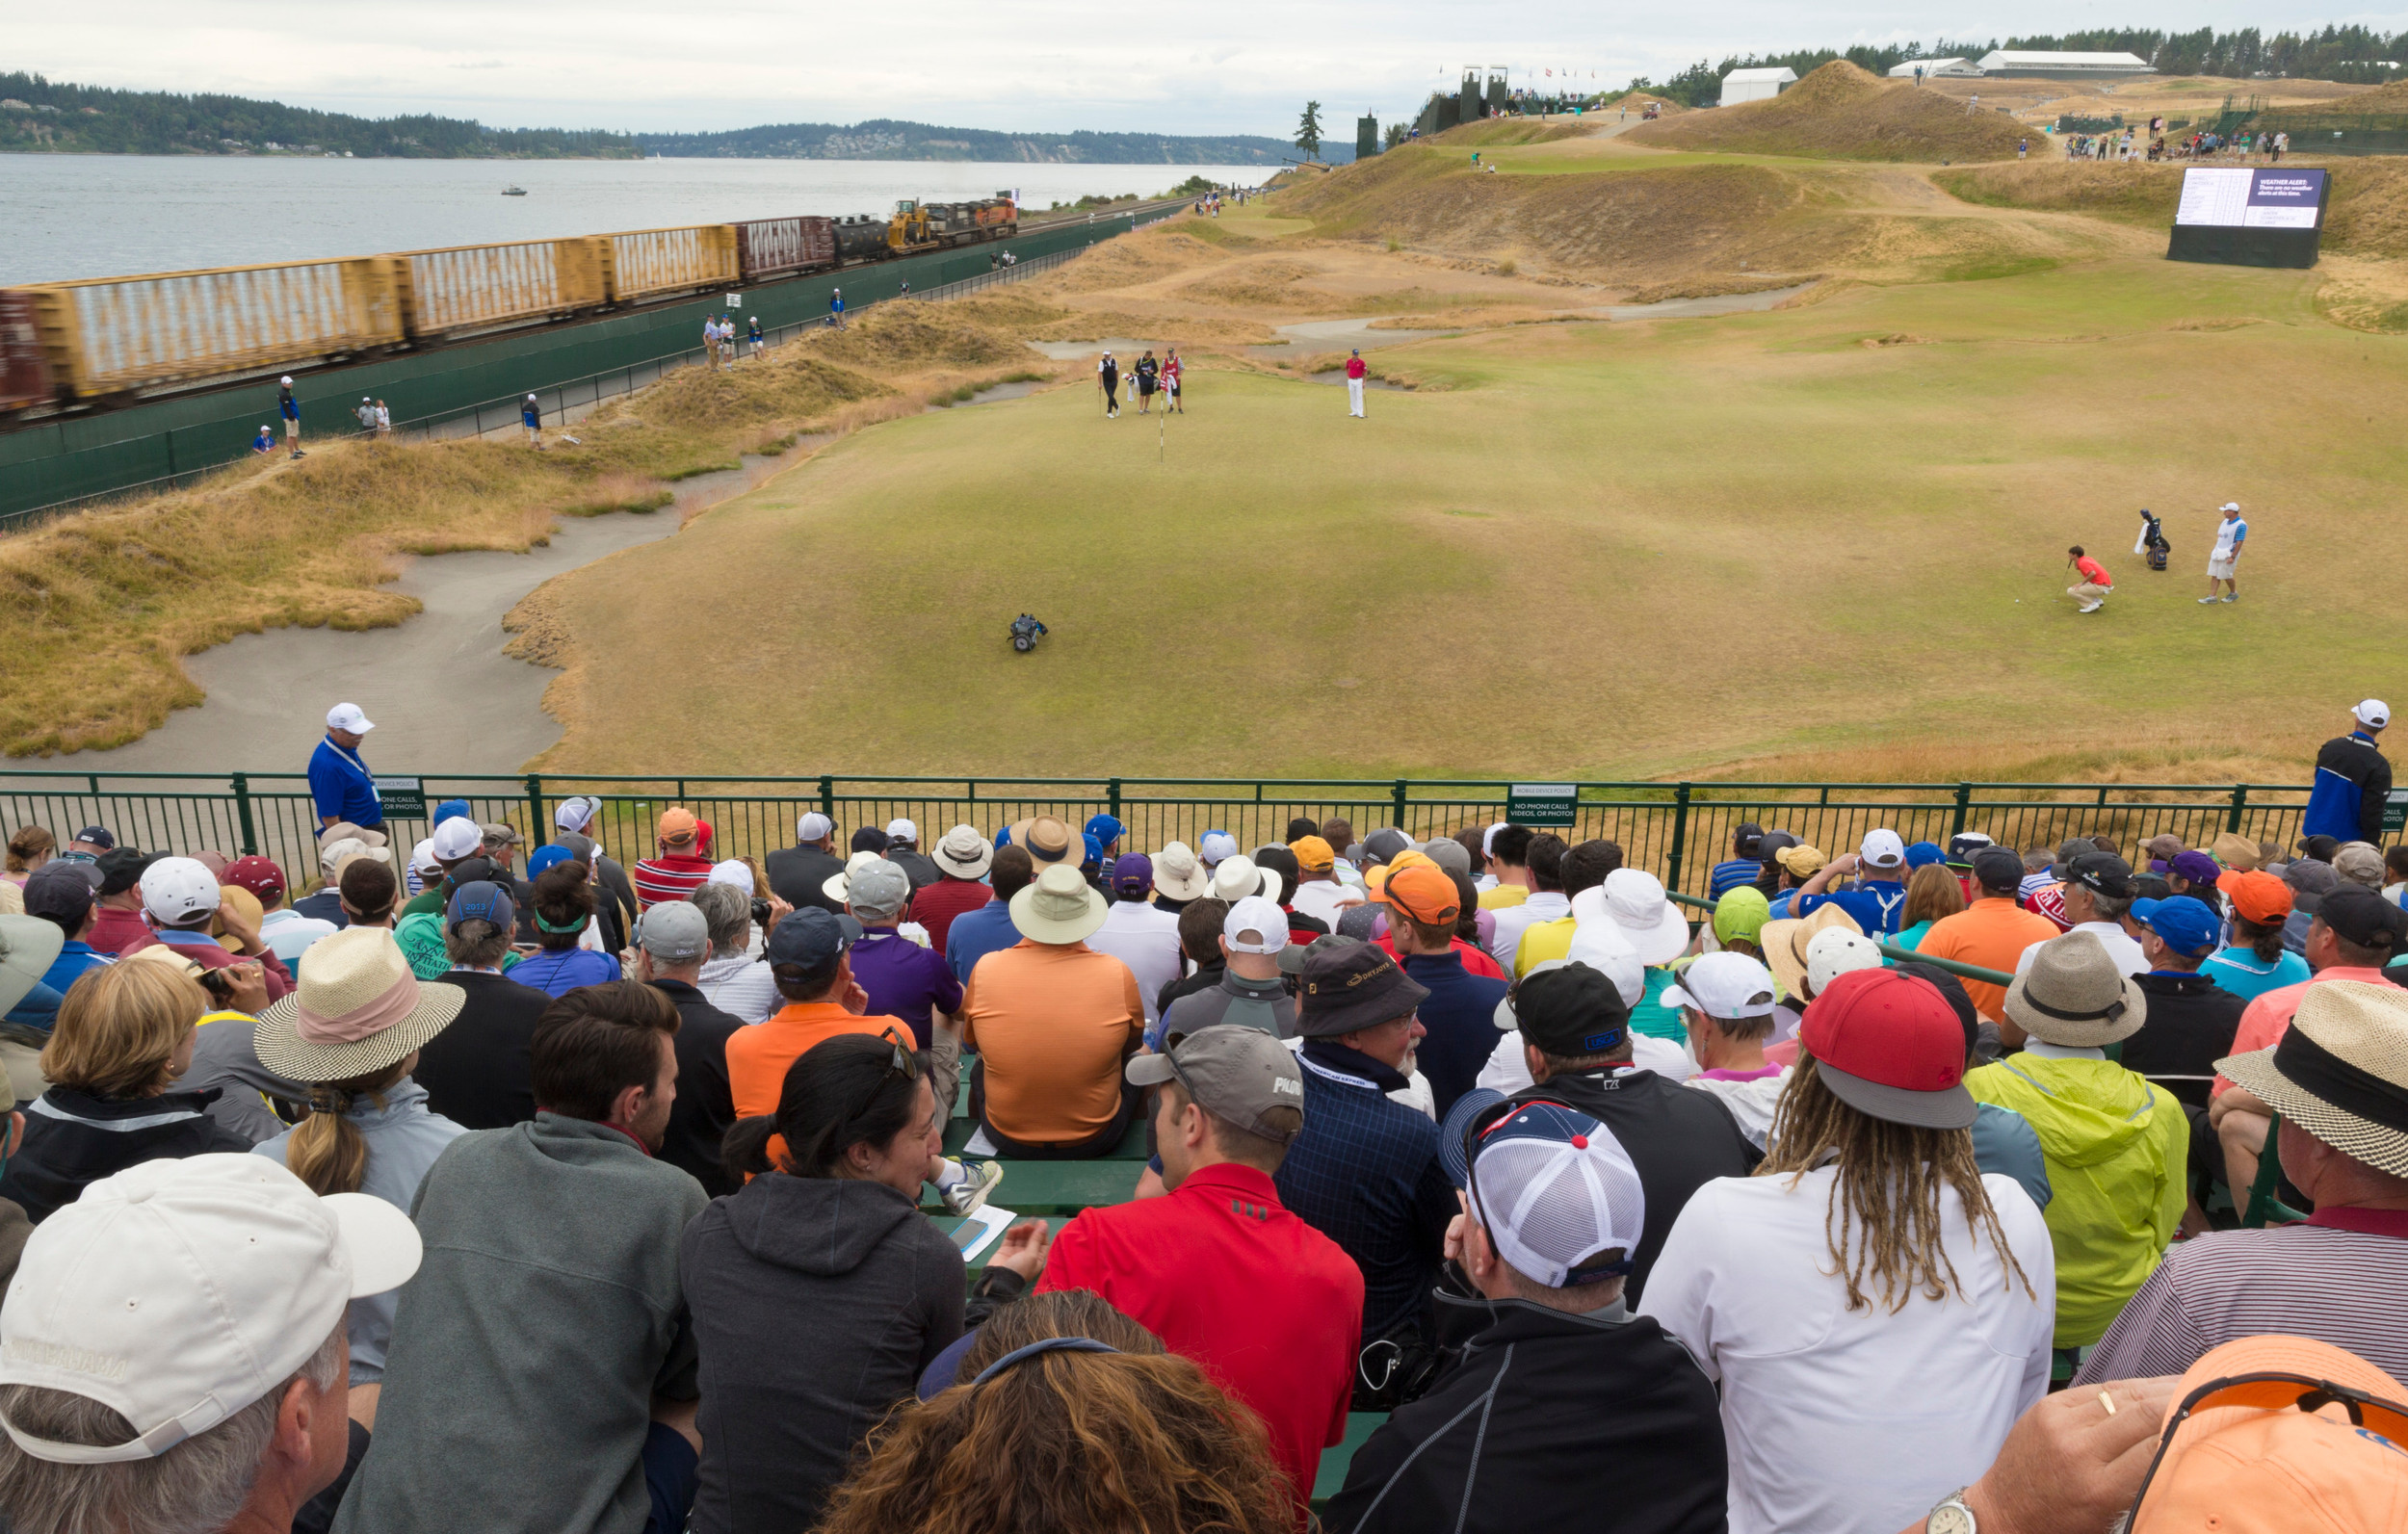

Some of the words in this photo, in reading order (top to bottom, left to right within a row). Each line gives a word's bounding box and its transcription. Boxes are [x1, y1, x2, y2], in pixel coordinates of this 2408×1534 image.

[1362, 961, 1391, 980] DRYJOYS
[1590, 1032, 1616, 1048] USGA
[1312, 1066, 1340, 1080] AMERICAN
[1341, 1077, 1366, 1086] EXPRESS
